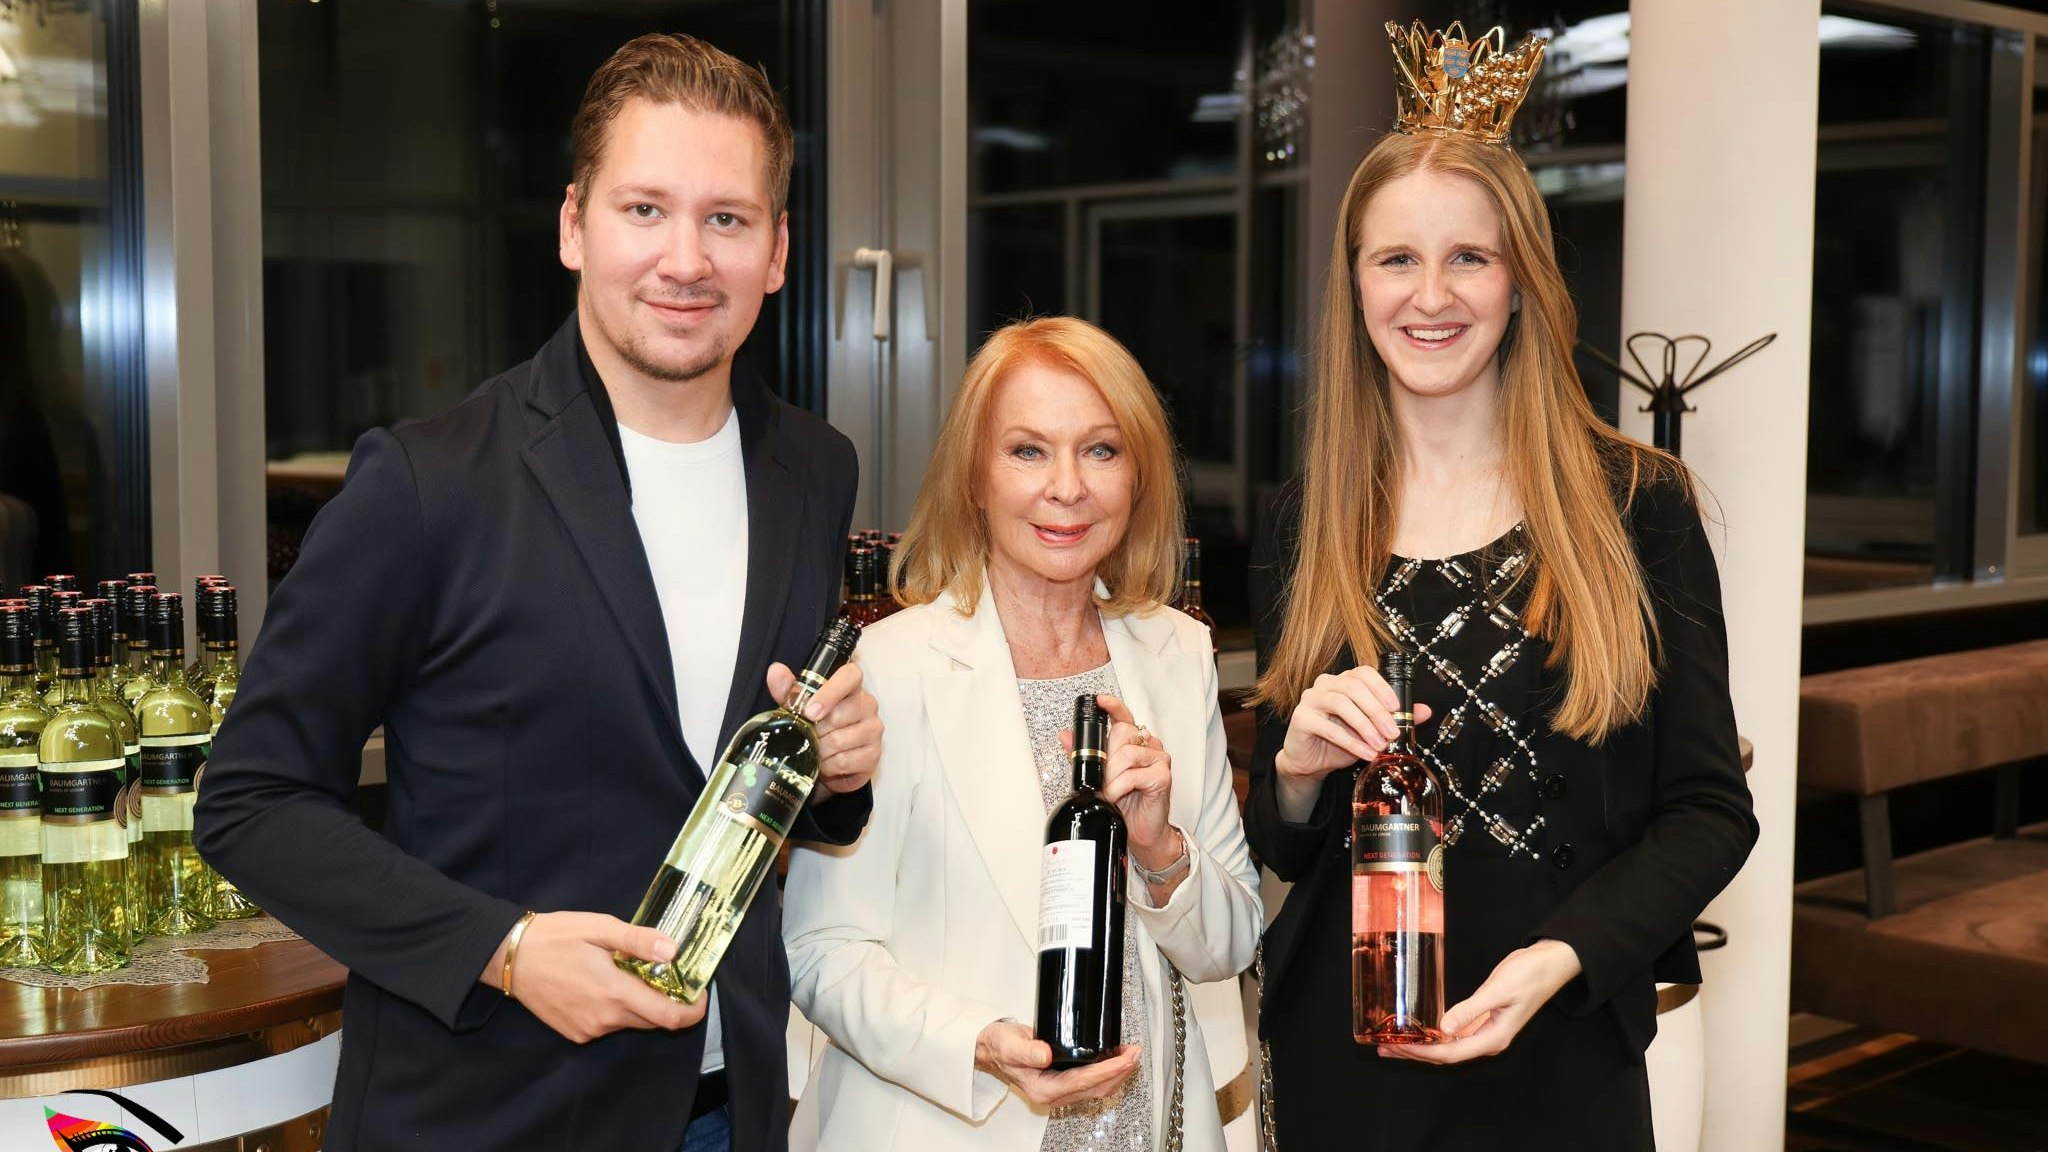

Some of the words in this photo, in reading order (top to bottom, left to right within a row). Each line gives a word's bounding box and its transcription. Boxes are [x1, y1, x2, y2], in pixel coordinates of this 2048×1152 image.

[142, 752, 193, 760] AUMGARTN
[0, 773, 36, 782] AUMGAR
[50, 778, 106, 787] BAUMGARTN
[68, 805, 105, 813] GENERATION
[1361, 822, 1420, 832] BAUMGARTNER
